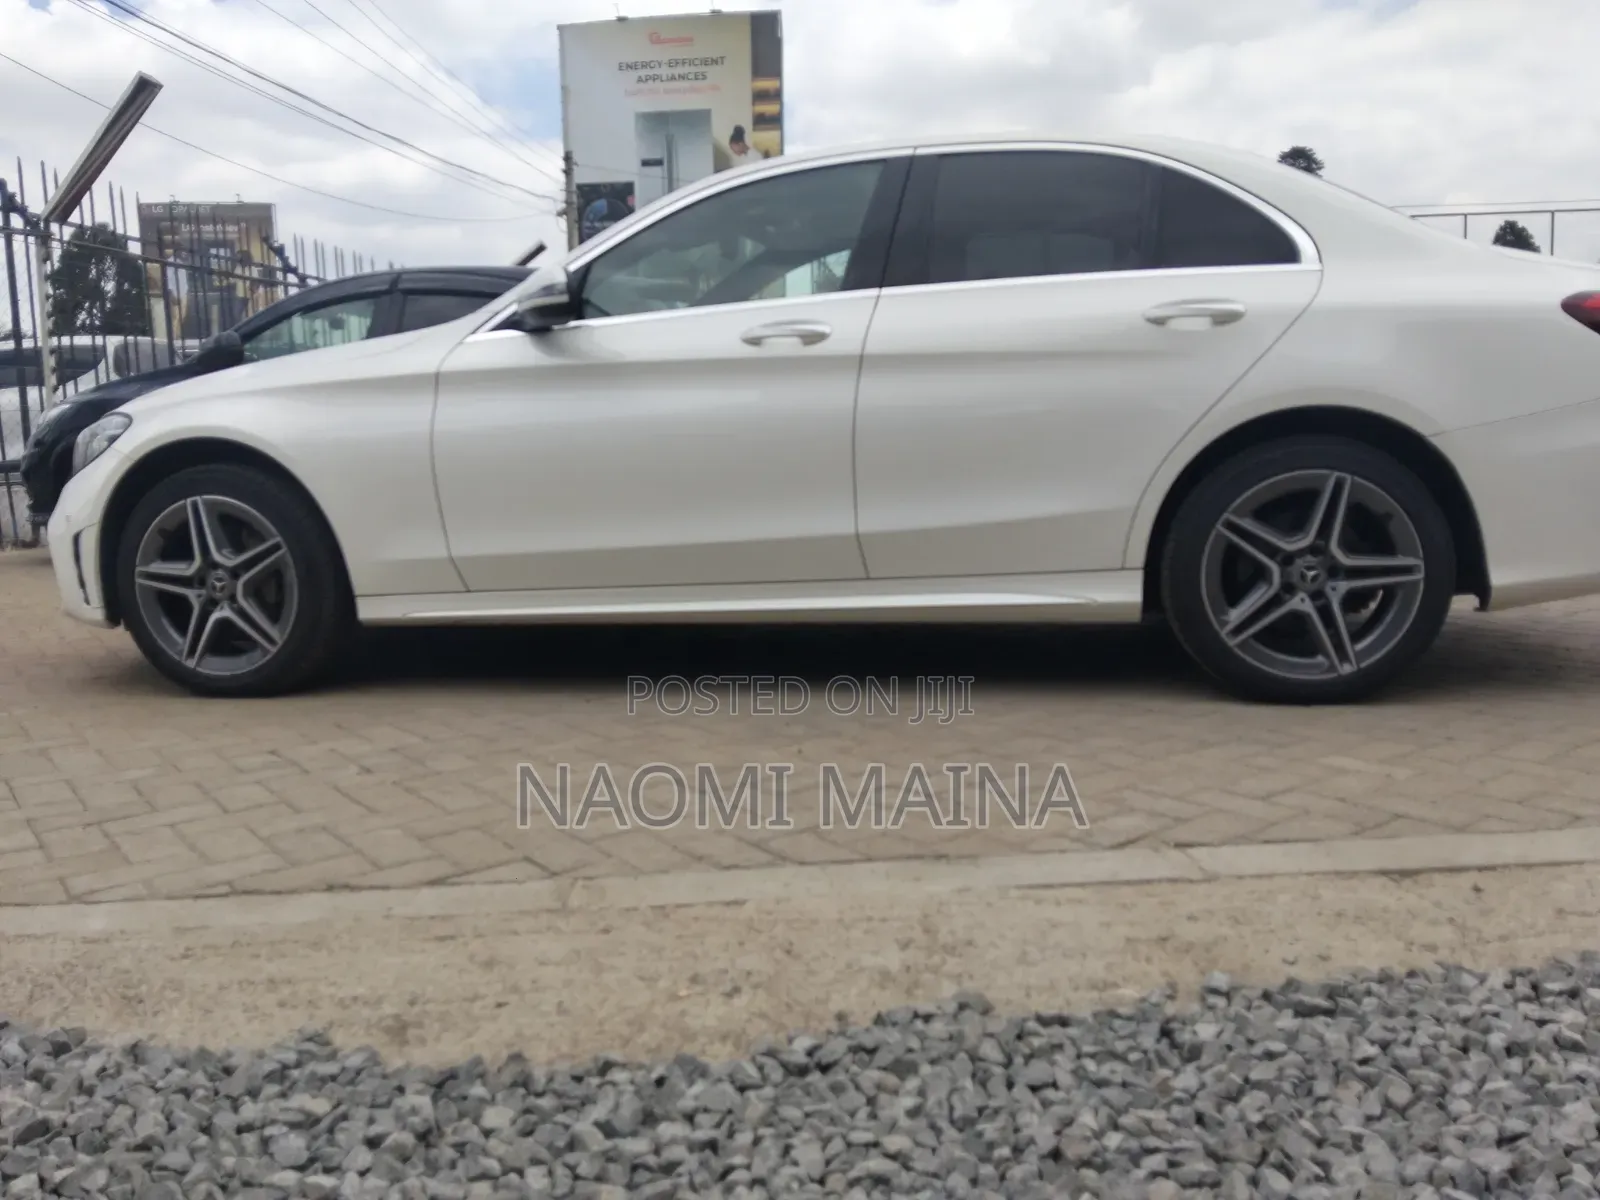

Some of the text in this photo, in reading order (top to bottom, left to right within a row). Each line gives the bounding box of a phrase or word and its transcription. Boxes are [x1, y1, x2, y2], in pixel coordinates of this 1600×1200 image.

[618, 56, 727, 71] ENERGY-EFFICIENT
[636, 71, 708, 84] APPLIANCES
[152, 205, 164, 213] LG
